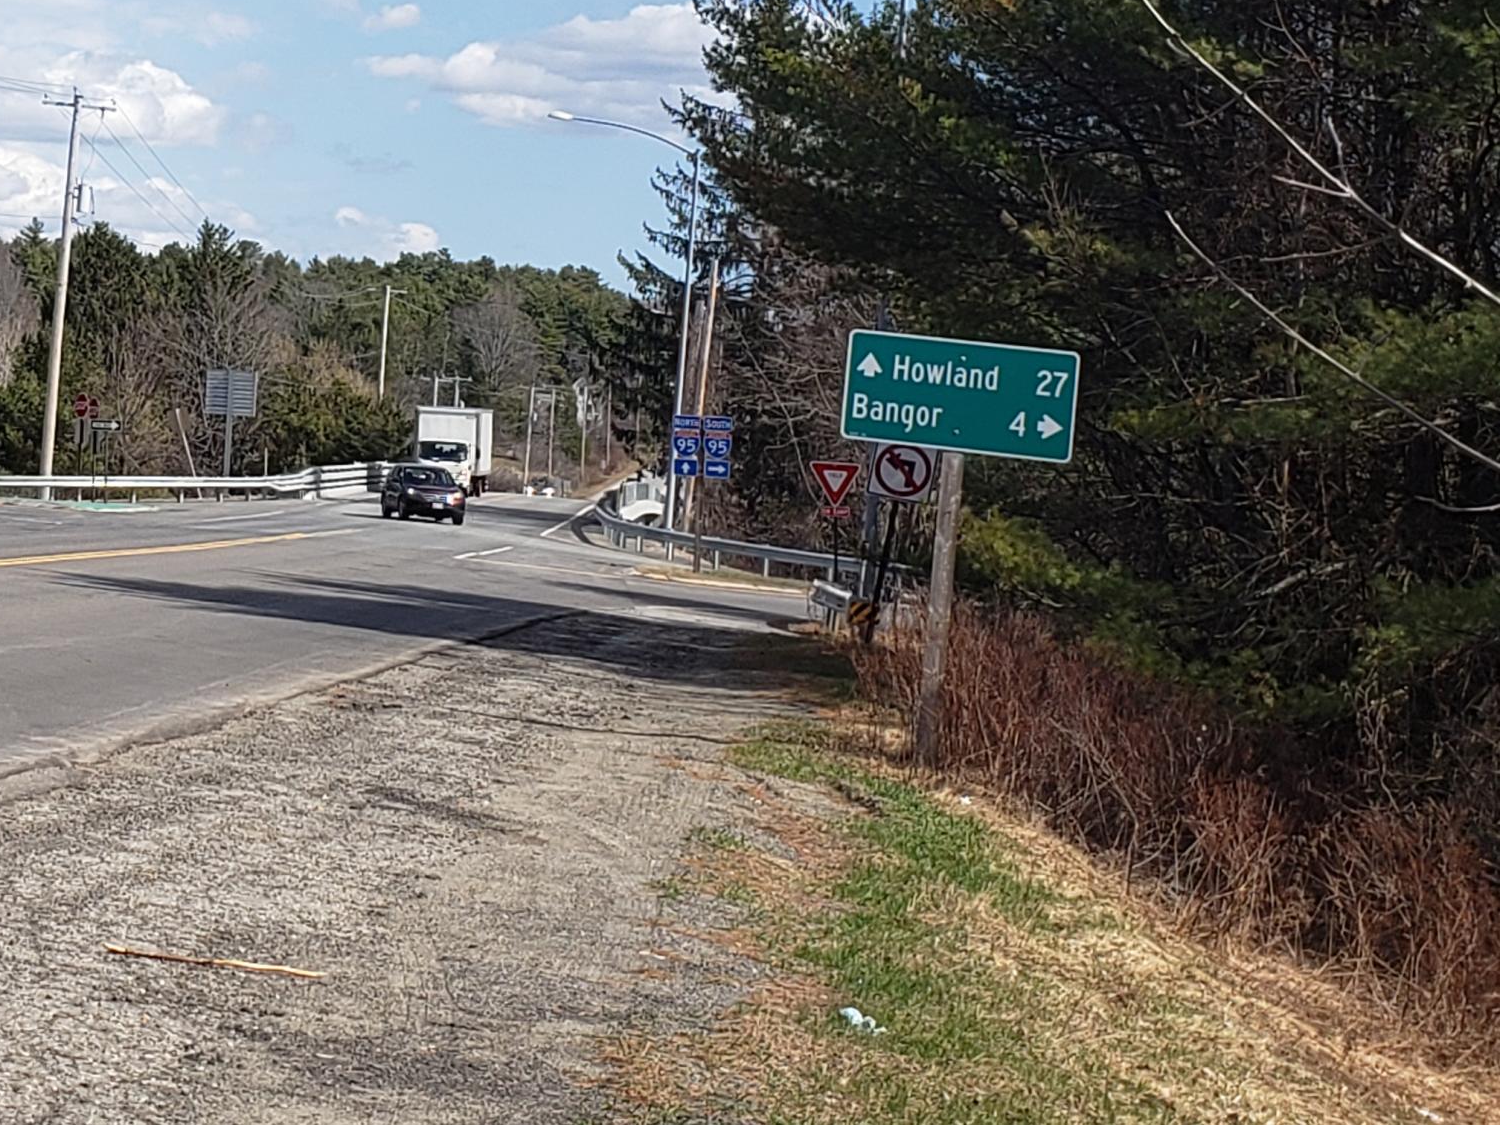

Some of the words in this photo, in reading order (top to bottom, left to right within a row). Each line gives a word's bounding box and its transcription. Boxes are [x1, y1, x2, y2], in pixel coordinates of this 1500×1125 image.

[892, 355, 999, 391] Howland
[1035, 370, 1069, 398] 27
[852, 393, 943, 433] Bangor
[1008, 411, 1026, 437] 4
[677, 438, 696, 453] 95
[708, 440, 727, 454] 95
